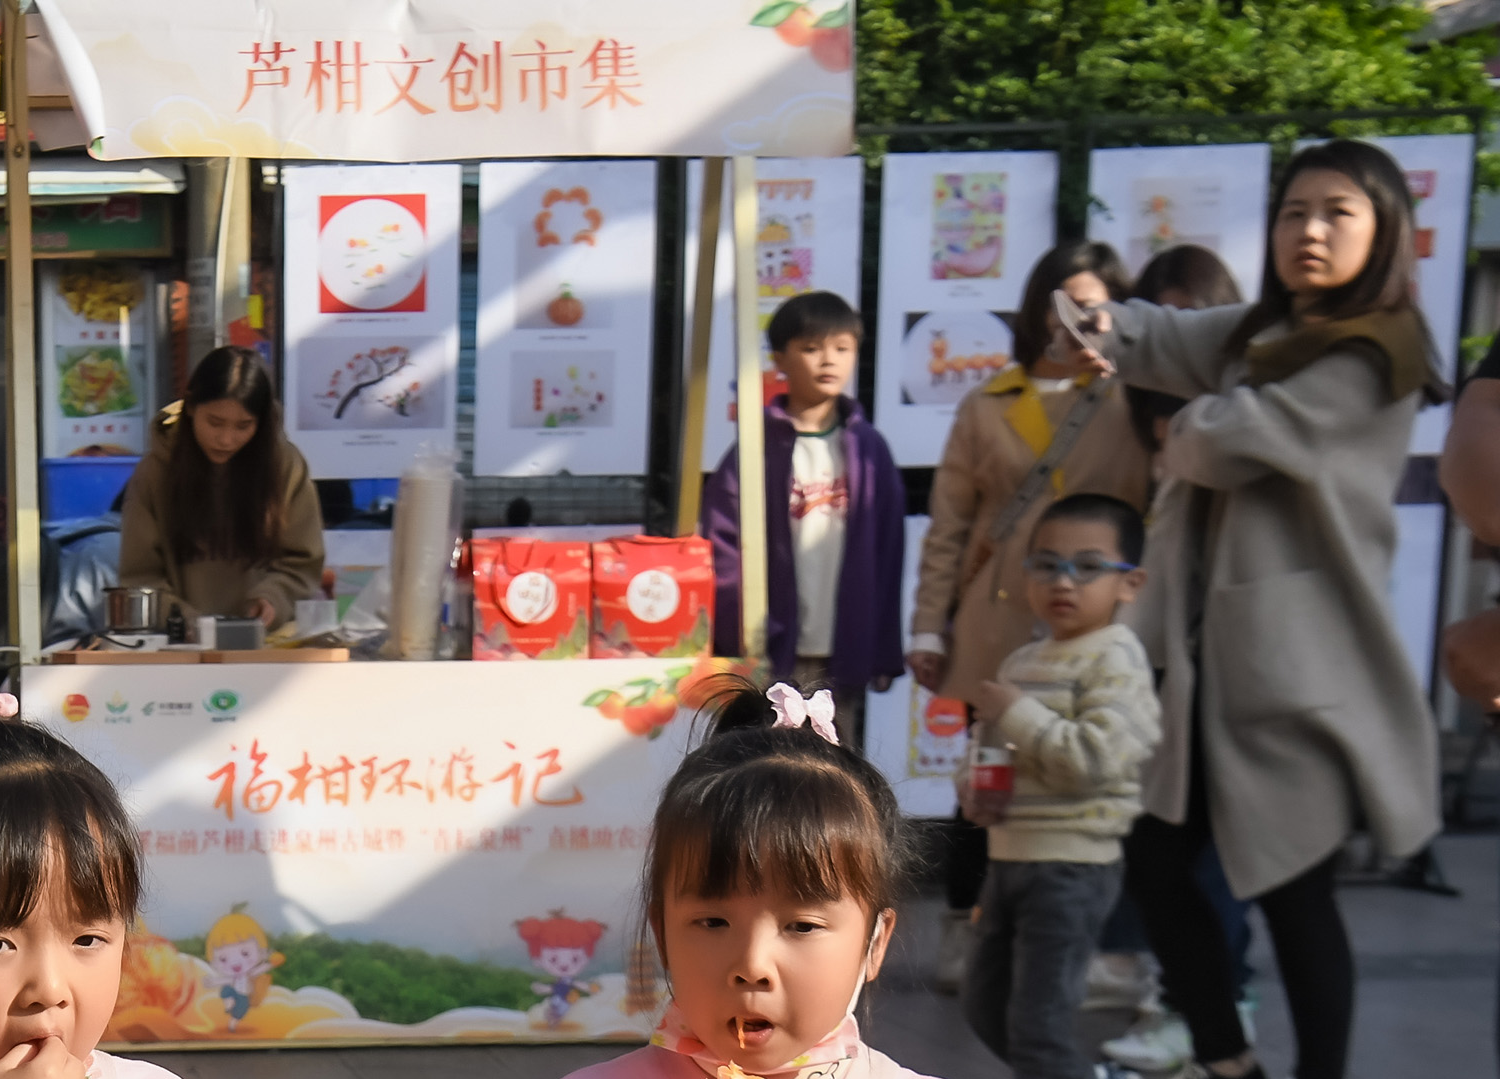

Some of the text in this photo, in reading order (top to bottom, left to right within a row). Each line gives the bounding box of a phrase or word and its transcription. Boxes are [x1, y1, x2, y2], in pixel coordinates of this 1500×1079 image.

[236, 38, 644, 116] 芦柑文创市集
[207, 738, 587, 822] 福柑环游记
